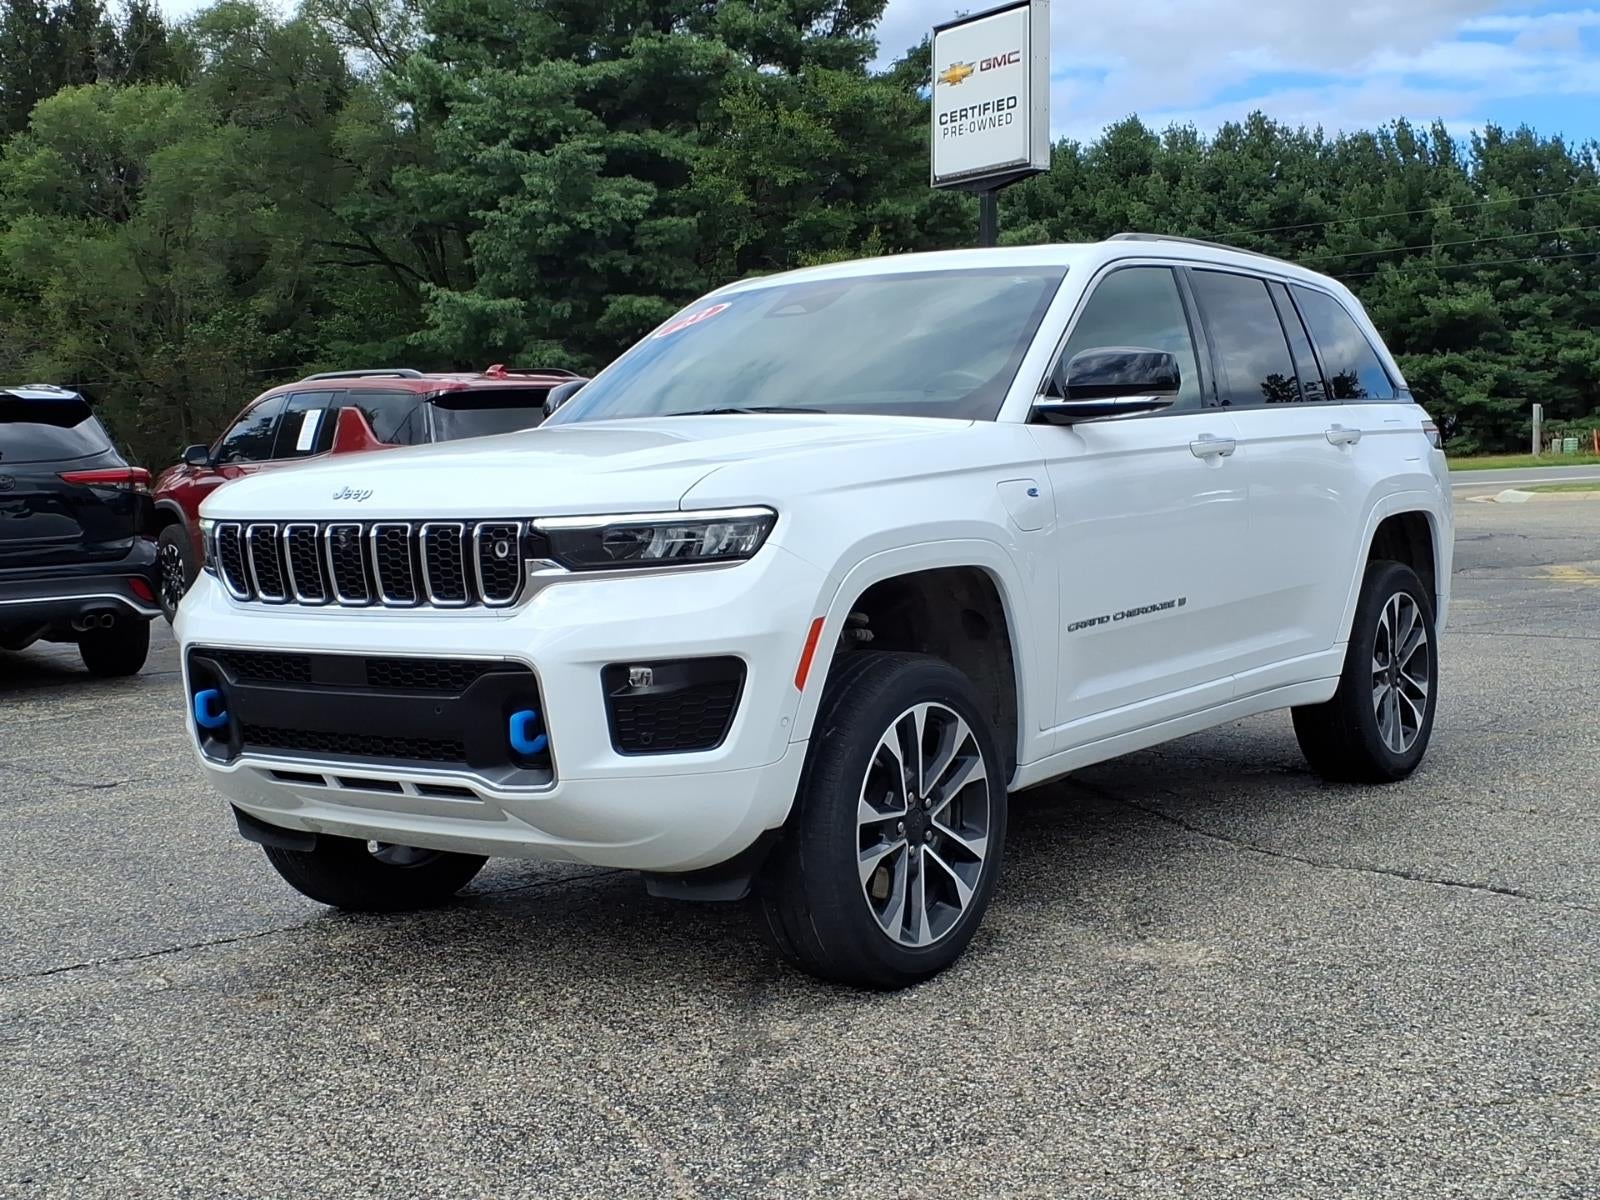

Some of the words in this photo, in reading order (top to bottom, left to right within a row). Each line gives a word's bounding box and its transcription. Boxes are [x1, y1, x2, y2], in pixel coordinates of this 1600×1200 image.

[980, 50, 1020, 72] GMC
[939, 96, 1017, 126] CERTIFIED
[943, 112, 1013, 139] PRE-OWNED
[332, 486, 374, 503] Jeep
[1067, 615, 1110, 632] GRAND
[1112, 599, 1176, 621] CHEROKEE
